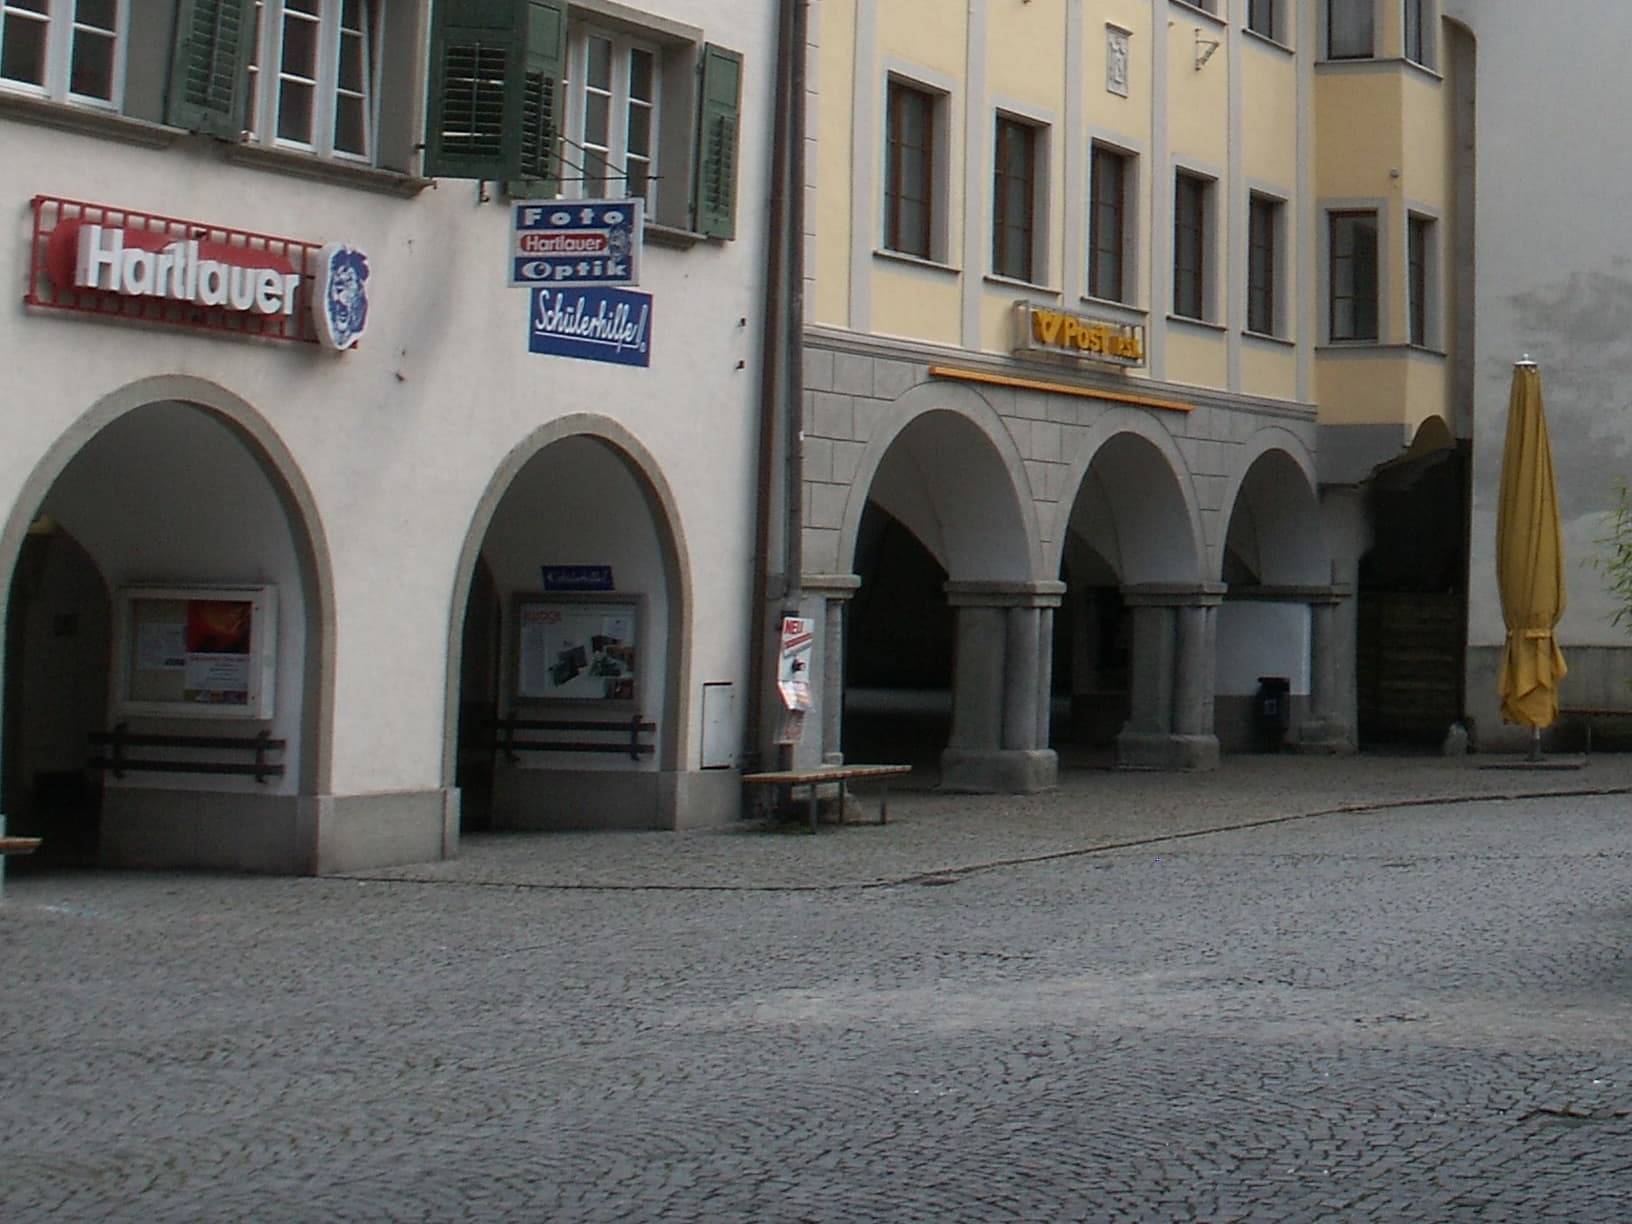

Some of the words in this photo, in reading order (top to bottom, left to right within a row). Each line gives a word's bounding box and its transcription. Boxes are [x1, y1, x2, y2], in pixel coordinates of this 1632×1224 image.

[524, 208, 624, 225] Foto
[525, 235, 602, 251] Hartlauer
[75, 224, 300, 316] Hartlauer
[522, 260, 627, 280] Optik
[535, 289, 649, 353] Schülerhilfe!
[1060, 315, 1110, 355] Post
